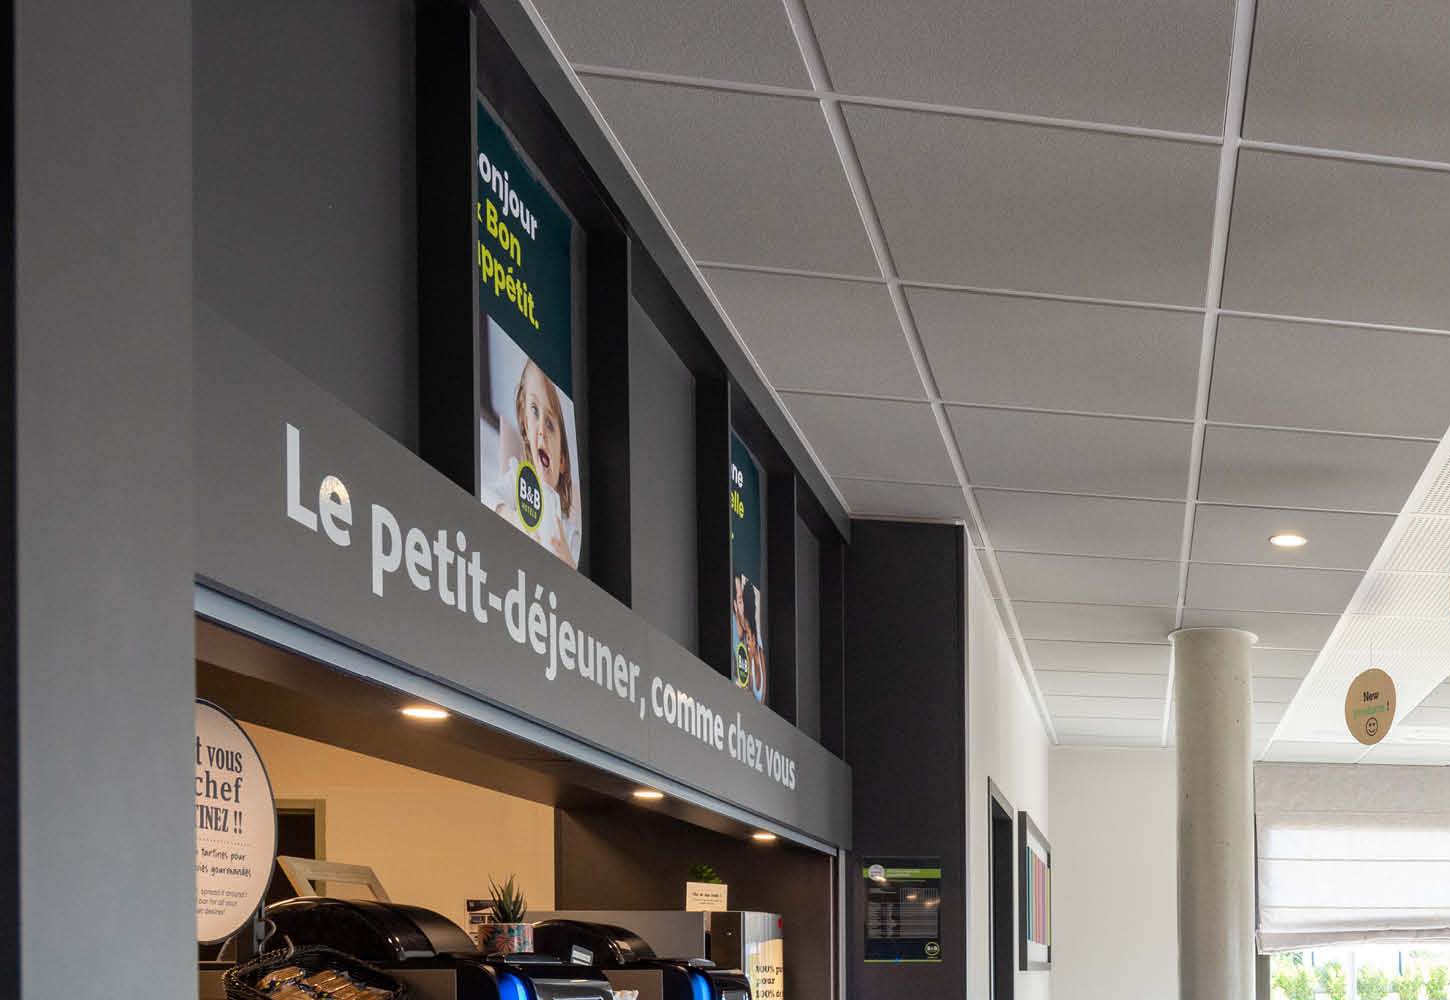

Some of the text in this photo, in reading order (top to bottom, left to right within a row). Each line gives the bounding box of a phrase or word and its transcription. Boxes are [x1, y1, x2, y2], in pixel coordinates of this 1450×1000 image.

[477, 152, 538, 240] onjour
[486, 198, 522, 267] Bon
[520, 477, 541, 510] B&B
[286, 422, 353, 547] Le
[651, 676, 724, 751] comme
[728, 711, 763, 773] chez
[765, 744, 796, 791] vous
[207, 745, 243, 773] vous
[195, 770, 243, 803] chef
